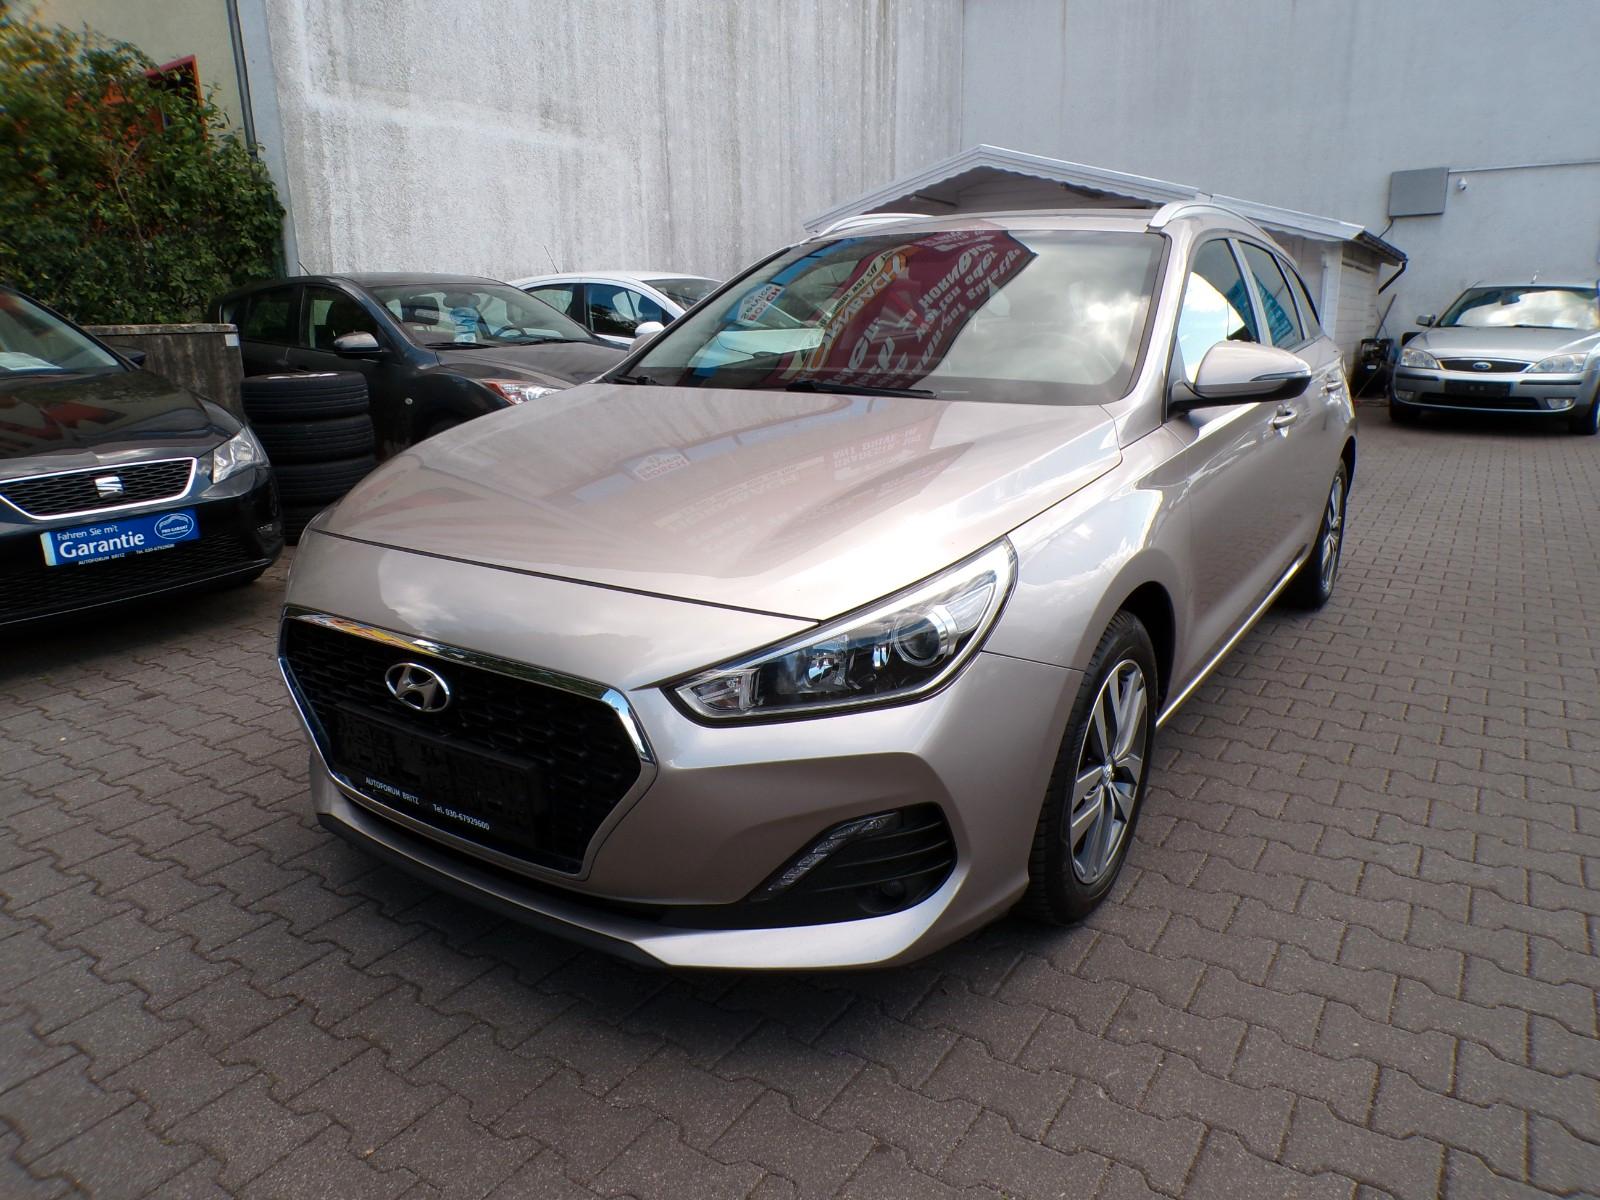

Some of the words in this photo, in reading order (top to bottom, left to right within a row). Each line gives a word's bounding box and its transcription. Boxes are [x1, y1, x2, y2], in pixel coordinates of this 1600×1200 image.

[57, 529, 88, 541] Fahren
[89, 527, 102, 537] Sie
[103, 525, 118, 534] mit
[59, 531, 145, 558] Garantie
[365, 776, 401, 797] AUTOFORUM
[401, 791, 420, 806] BRITZ
[432, 803, 445, 815] Tel.
[445, 808, 490, 831] 030-67929600
